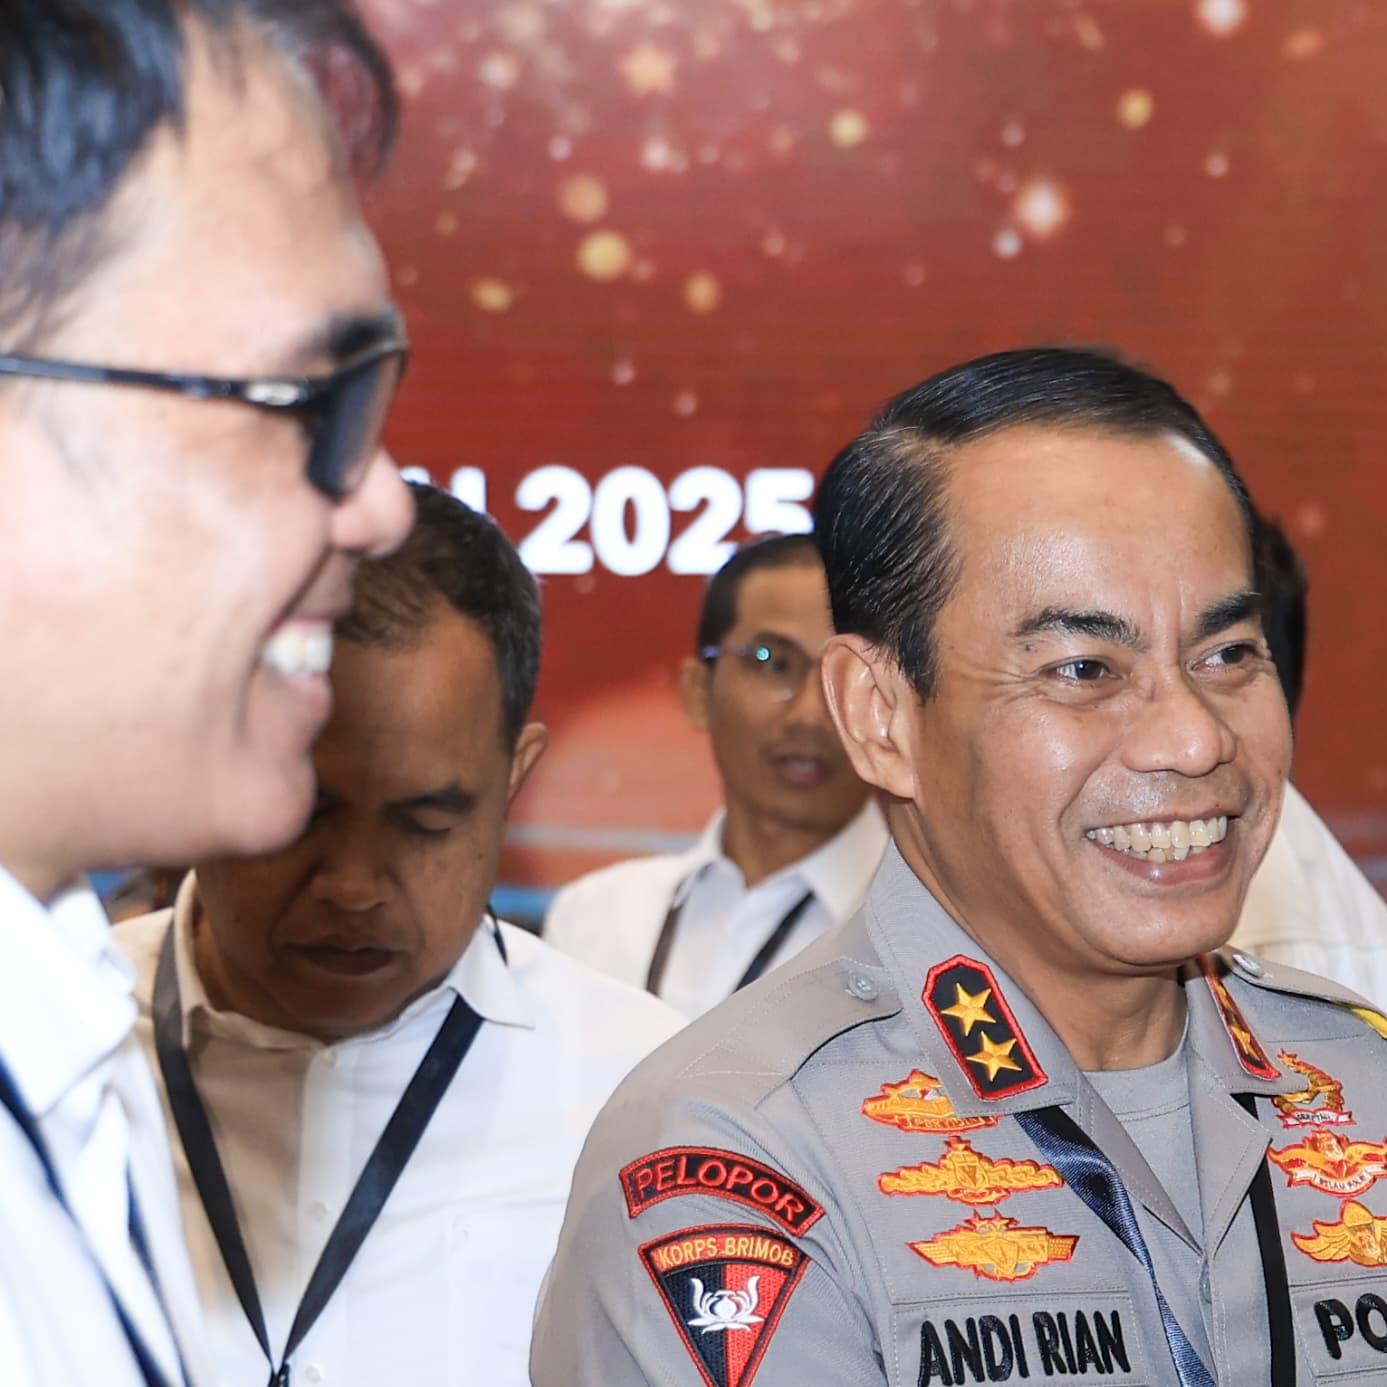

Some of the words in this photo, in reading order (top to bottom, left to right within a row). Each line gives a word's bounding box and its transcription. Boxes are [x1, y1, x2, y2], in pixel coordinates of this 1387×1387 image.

[516, 464, 814, 577] 2025
[636, 1155, 806, 1224] PELOPOR
[658, 1236, 718, 1269] KORPS
[724, 1236, 794, 1267] BRIMOB
[1033, 1309, 1131, 1377] RIAN
